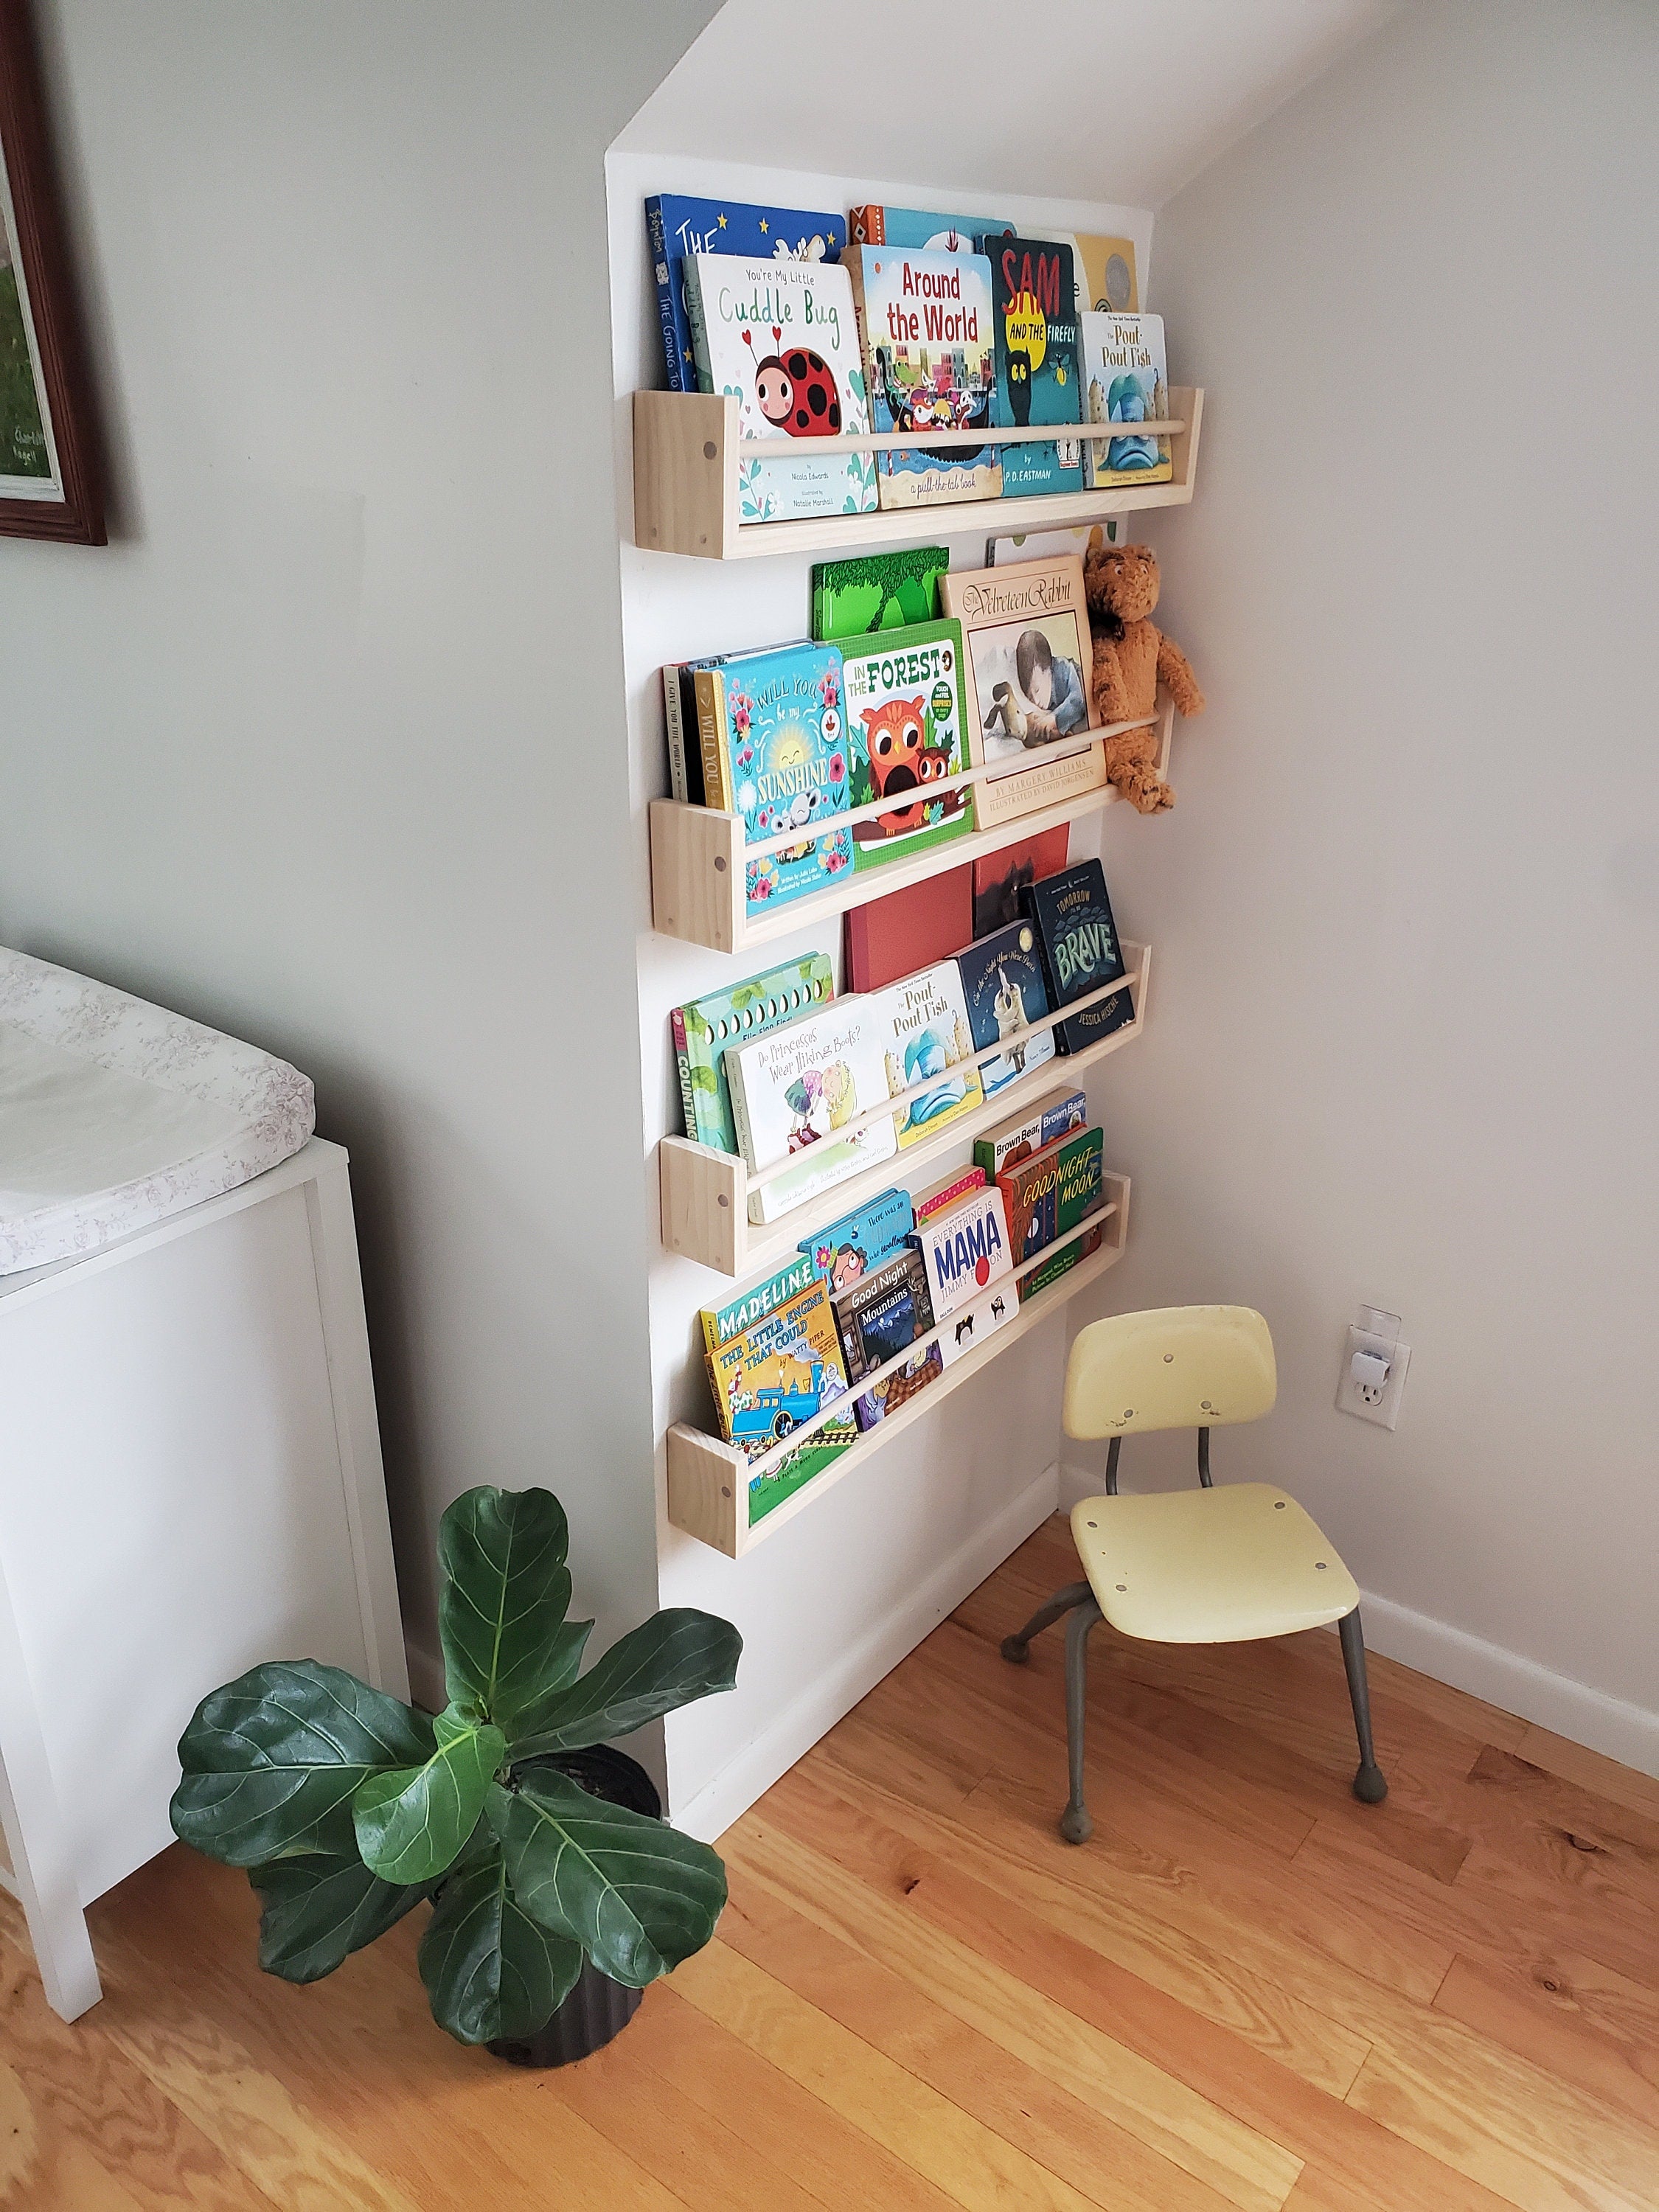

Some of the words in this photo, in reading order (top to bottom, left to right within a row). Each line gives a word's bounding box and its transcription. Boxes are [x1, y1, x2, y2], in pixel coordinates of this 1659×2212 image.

[675, 218, 718, 256] THE
[745, 268, 772, 281] You're
[775, 270, 787, 285] My
[790, 271, 815, 285] Little
[903, 262, 960, 300] Around
[1001, 248, 1060, 316] SAM
[660, 296, 672, 320] THE
[719, 287, 793, 324] Cuddle
[804, 289, 841, 351] Bug
[886, 302, 919, 341] the
[923, 304, 978, 343] World
[664, 325, 678, 368] GOING
[1009, 323, 1027, 339] AND
[1029, 323, 1044, 341] THE
[1047, 325, 1076, 343] FIREFLY
[1102, 347, 1127, 368] Pout
[1130, 347, 1152, 367] Fish
[669, 372, 681, 388] TO
[808, 472, 829, 480] Edwards
[1024, 453, 1032, 465] by
[911, 485, 916, 493] a
[960, 473, 977, 489] book
[1028, 577, 1071, 609] Rabbit
[848, 681, 866, 697] THE
[867, 649, 940, 693] FOREST
[854, 665, 866, 680] IN
[757, 681, 790, 712] WILL
[793, 678, 817, 700] YOU
[776, 703, 785, 722] be
[789, 706, 800, 720] my
[701, 714, 716, 750] WILL
[673, 744, 681, 768] WORLD
[705, 754, 719, 785] YOU
[757, 758, 828, 804] SUNSHINE
[990, 793, 1032, 811] ILLUSTRATED
[1032, 788, 1040, 796] BY
[1042, 781, 1060, 793] DAVID
[1062, 770, 1094, 787] JORGENSEN
[996, 786, 1004, 797] BY
[1008, 772, 1048, 793] MARGERY
[1048, 759, 1086, 779] WILLIAMS
[1056, 889, 1090, 915] TOMORROW
[1055, 923, 1116, 990] BRAVE
[973, 991, 980, 1006] On
[996, 950, 1009, 965] You
[1008, 950, 1023, 961] Were
[1022, 954, 1036, 973] Born
[891, 1007, 922, 1038] Pout
[923, 996, 948, 1023] Fish
[1078, 1012, 1102, 1026] JESSICA
[1100, 995, 1119, 1020] HISCHE
[758, 1051, 768, 1068] Do
[770, 1027, 818, 1062] Princesses
[768, 1061, 793, 1085] Wear
[796, 1045, 832, 1074] Hiking
[833, 1026, 861, 1053] Boots?
[678, 1055, 698, 1141] COUNTING
[996, 1135, 1020, 1156] Brown
[1021, 1124, 1040, 1141] Bear,
[1043, 1107, 1067, 1128] Brown
[1067, 1097, 1086, 1114] Bear,
[1023, 1147, 1093, 1207] GOODNIGHT
[1062, 1169, 1094, 1206] MOON
[868, 1212, 884, 1227] There
[884, 1204, 896, 1216] was
[897, 1201, 904, 1209] an
[932, 1206, 983, 1247] EVERYTHING
[985, 1200, 992, 1212] IS
[933, 1211, 1001, 1289] MAMA
[720, 1262, 812, 1340] MADELINE
[852, 1279, 877, 1308] Good
[879, 1262, 908, 1290] Night
[941, 1274, 967, 1303] JIMMY
[861, 1288, 908, 1326] Mountains
[939, 1307, 953, 1319] BALLOON
[720, 1344, 744, 1369] THE
[747, 1318, 784, 1353] LITTLE
[786, 1290, 824, 1325] ENGINE
[744, 1342, 772, 1371] THAT
[775, 1318, 808, 1350] COULD
[779, 1357, 787, 1368] by
[787, 1341, 807, 1359] WATTY
[809, 1329, 825, 1345] PIPER
[711, 1383, 723, 1412] Little
